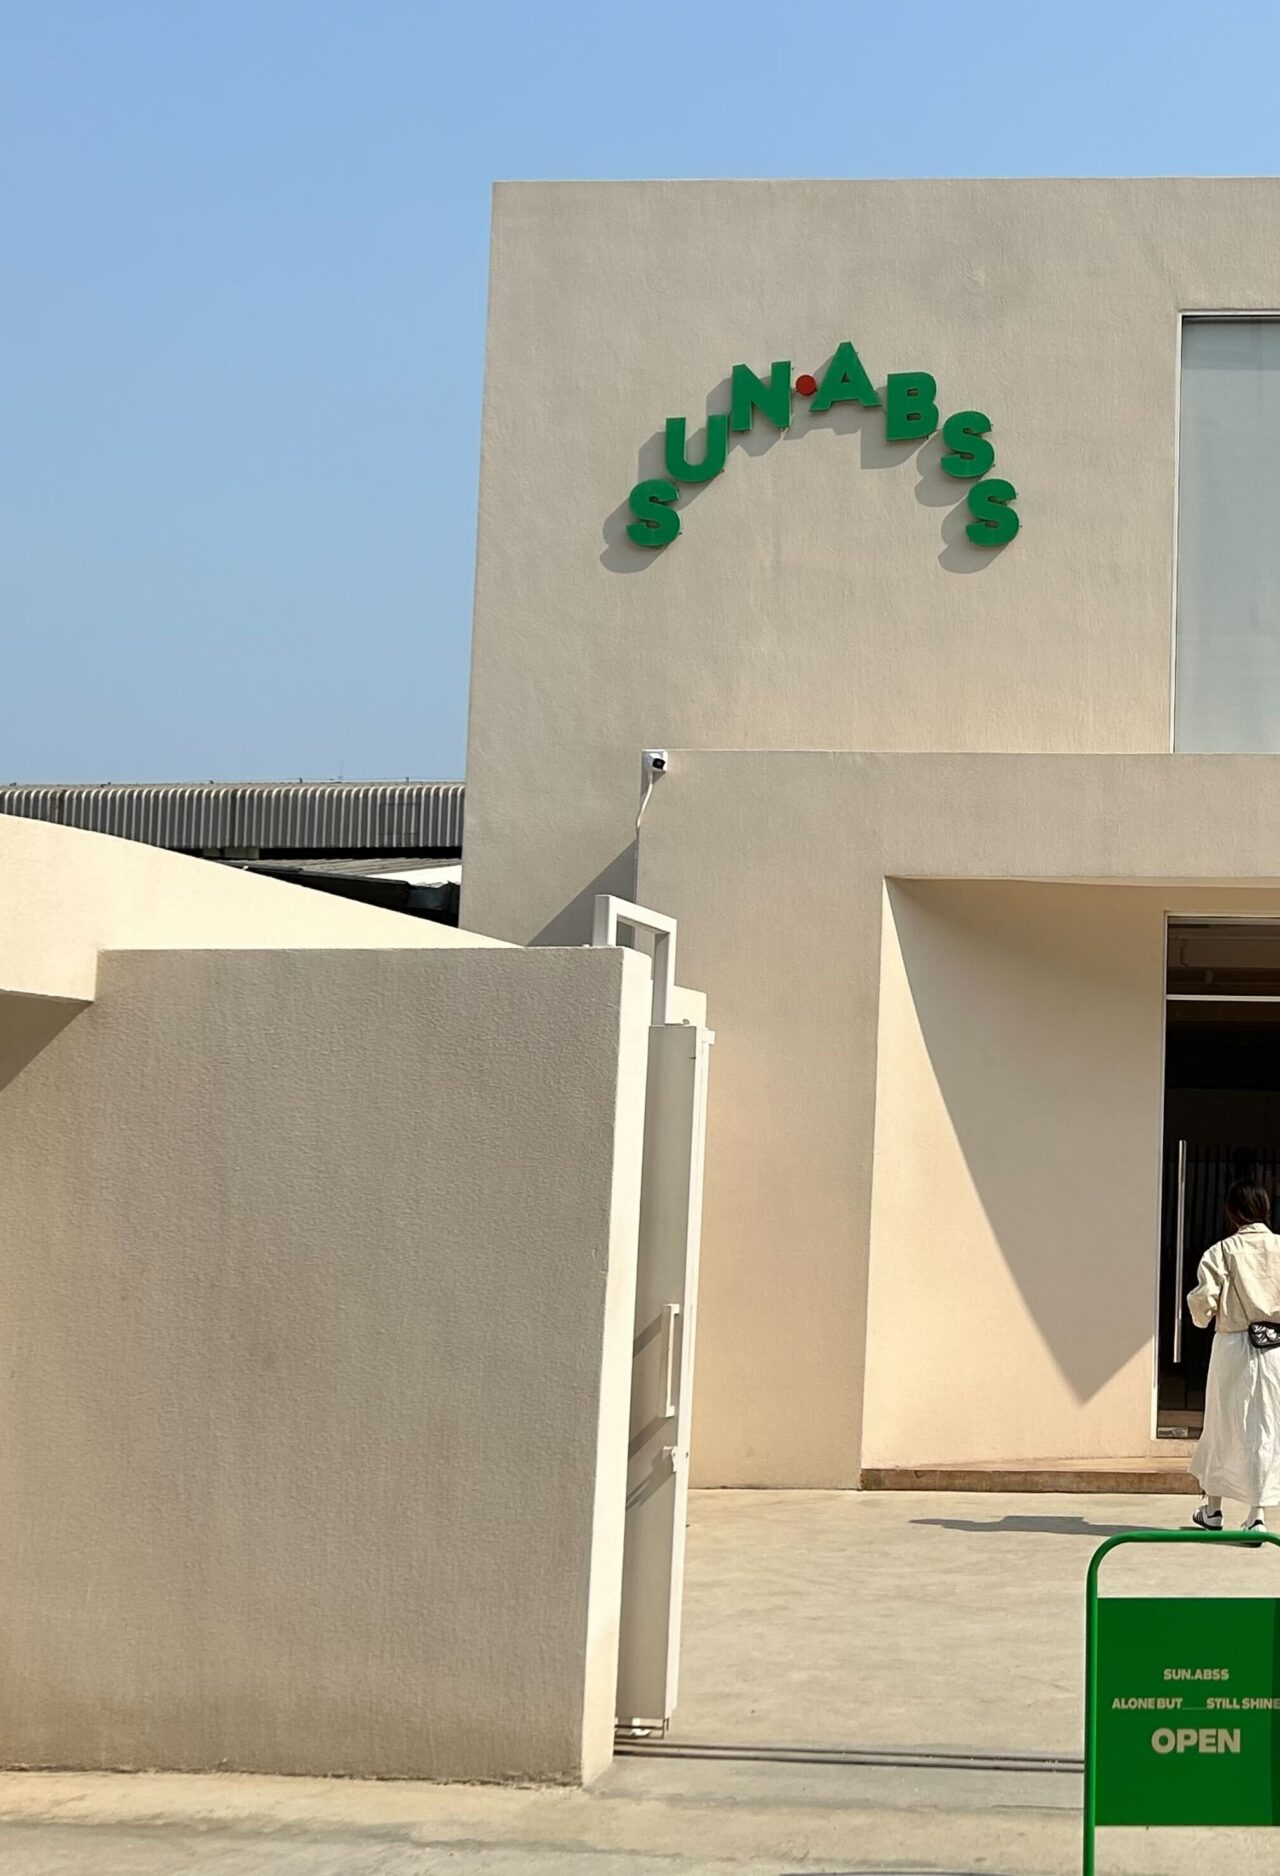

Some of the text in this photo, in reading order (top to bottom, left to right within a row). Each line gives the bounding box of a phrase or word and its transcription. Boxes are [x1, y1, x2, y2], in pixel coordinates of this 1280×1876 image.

[1163, 1668, 1230, 1681] SUN.ABSS
[1111, 1697, 1156, 1710] ALONE
[1206, 1697, 1241, 1710] STILL
[1241, 1697, 1280, 1710] SHINE
[1151, 1727, 1241, 1755] OPEN
